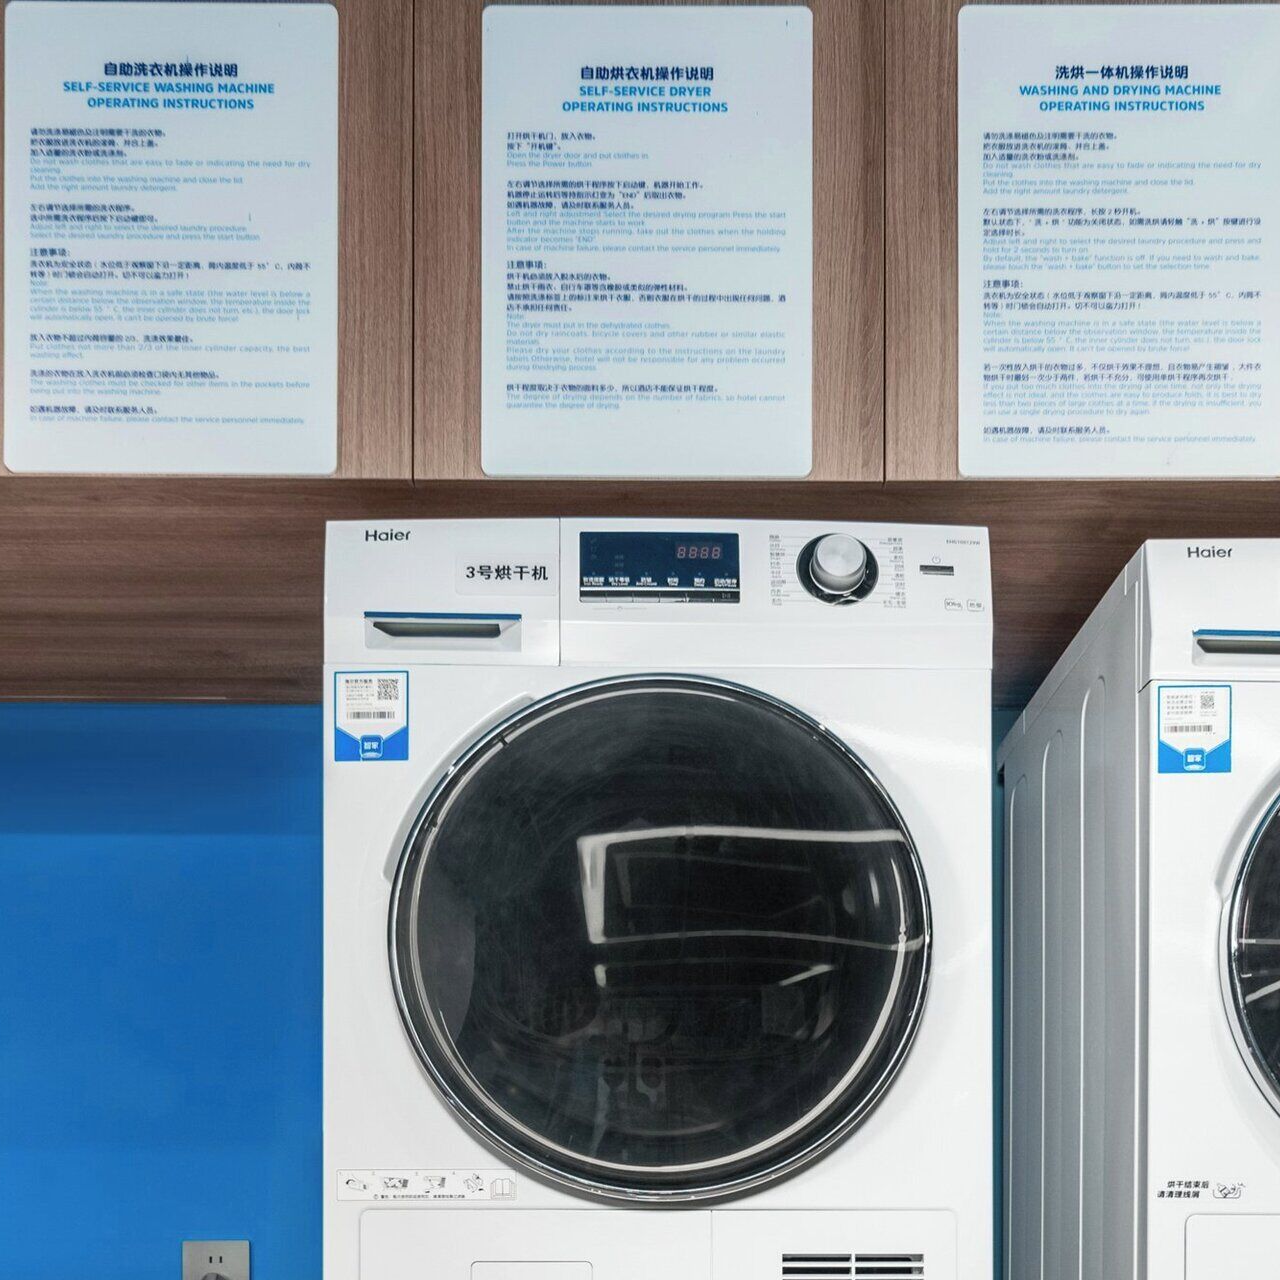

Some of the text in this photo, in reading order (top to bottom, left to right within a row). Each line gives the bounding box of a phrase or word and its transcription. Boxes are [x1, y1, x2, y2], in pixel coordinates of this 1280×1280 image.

[104, 62, 238, 77] 自助洗衣机操作说明
[581, 66, 714, 81] 自助烘衣机操作说明
[1056, 65, 1189, 80] 洗烘一体机操作说明
[64, 82, 274, 94] SELF-SERVICE WASHING MACHINE
[580, 86, 711, 97] SELF-SERVICE DRYER
[1020, 85, 1221, 96] WASHING AND DRYING MACHINE
[88, 98, 254, 109] OPERATING INSTRUCTIONS
[562, 102, 728, 112] OPERATING INSTRUCTIONS
[1039, 101, 1205, 111] OPERATING INSTRUCTIONS
[365, 529, 411, 542] Haier
[1187, 547, 1232, 558] Haier
[465, 565, 548, 581] 3号烘干机
